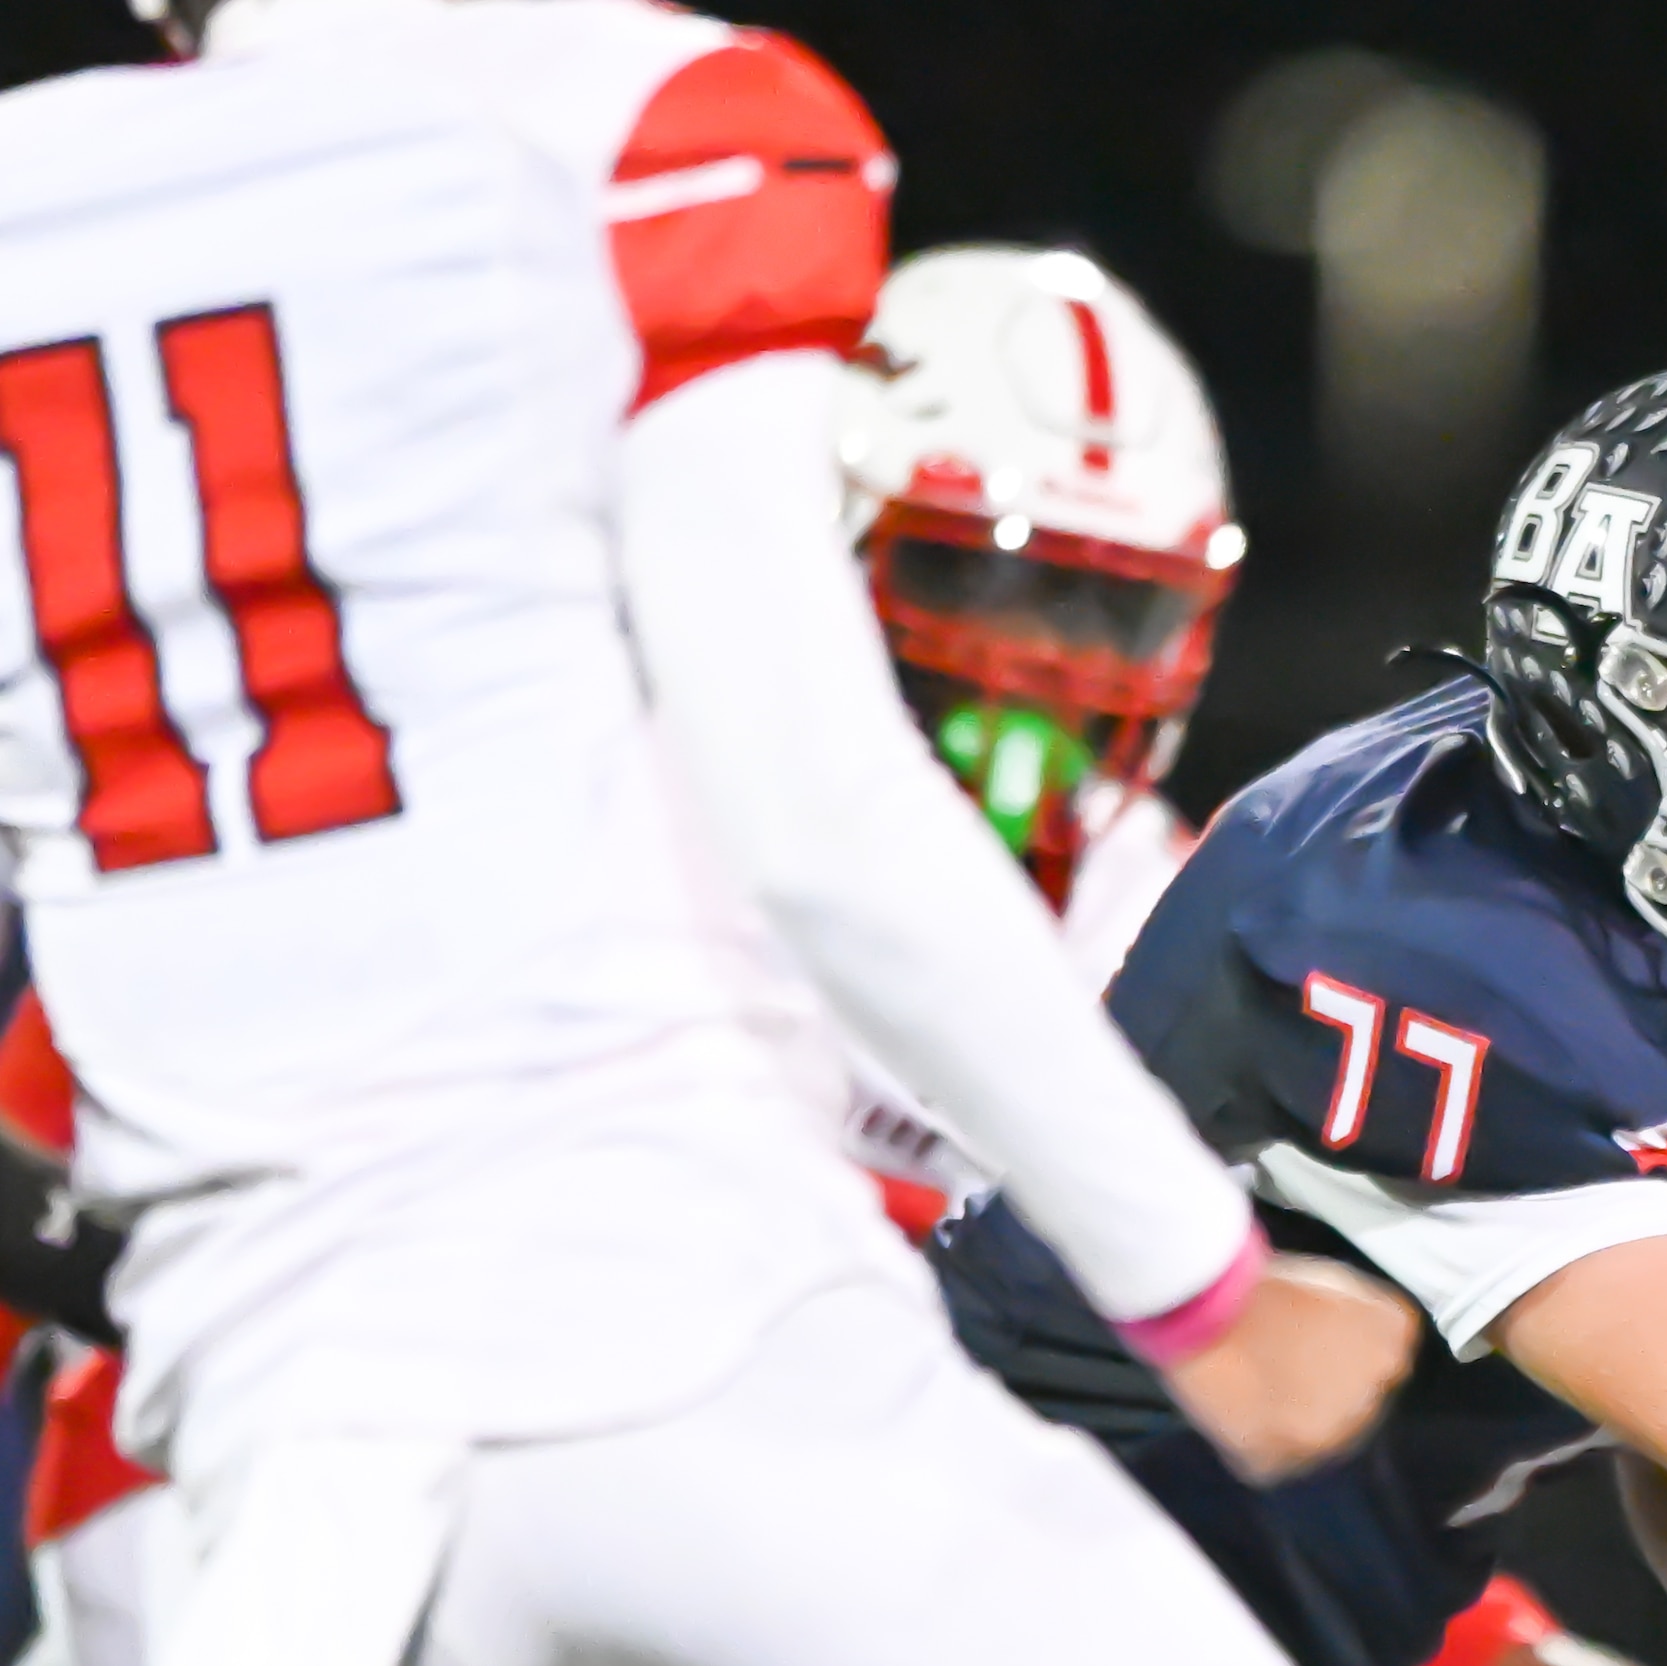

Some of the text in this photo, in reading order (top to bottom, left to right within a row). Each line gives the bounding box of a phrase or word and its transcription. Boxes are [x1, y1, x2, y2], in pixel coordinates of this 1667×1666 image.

[0, 302, 404, 874] 11
[1491, 440, 1663, 646] BA
[1303, 970, 1490, 1184] 77
